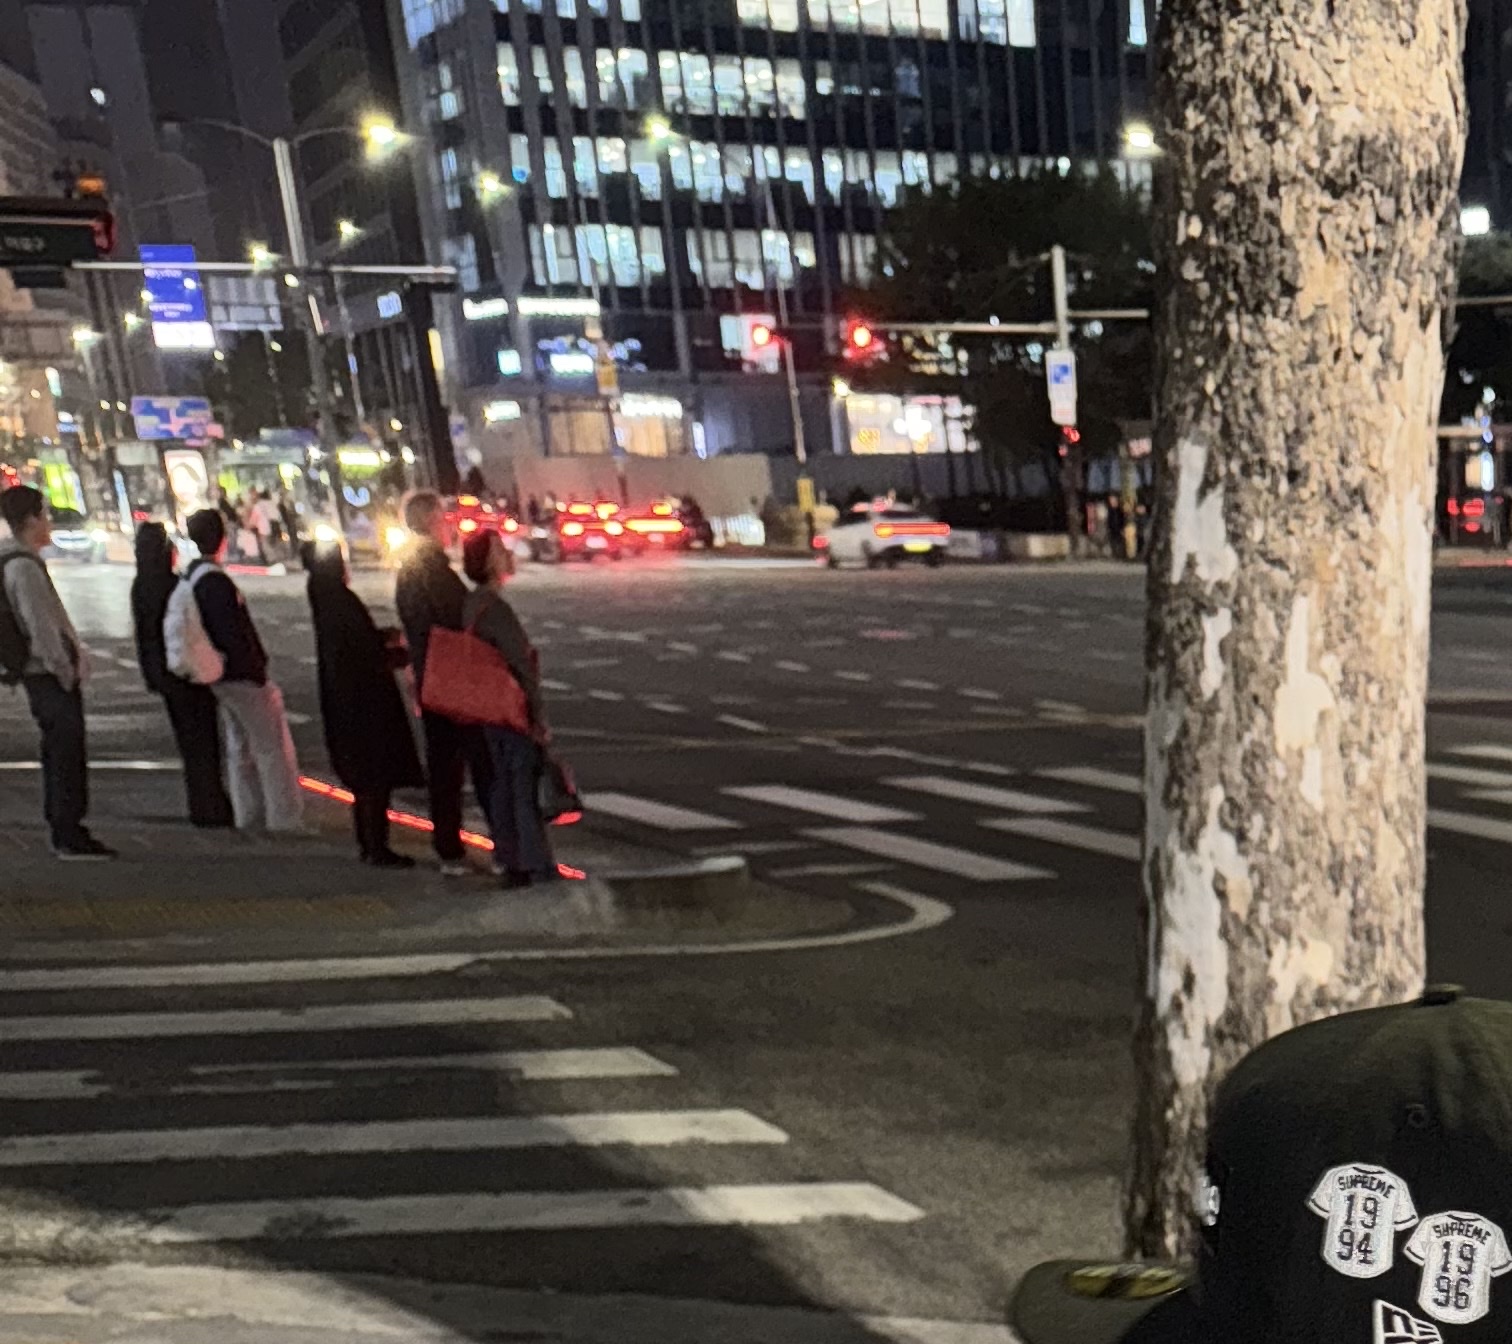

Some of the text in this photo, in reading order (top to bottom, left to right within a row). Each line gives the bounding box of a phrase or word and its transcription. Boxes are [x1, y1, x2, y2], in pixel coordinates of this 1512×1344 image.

[1337, 1174, 1396, 1199] SUPREME
[1343, 1193, 1379, 1229] 19
[1337, 1229, 1373, 1265] 94
[1433, 1221, 1492, 1246] SUPREME
[1441, 1240, 1476, 1275] 19
[1434, 1275, 1471, 1310] 96
